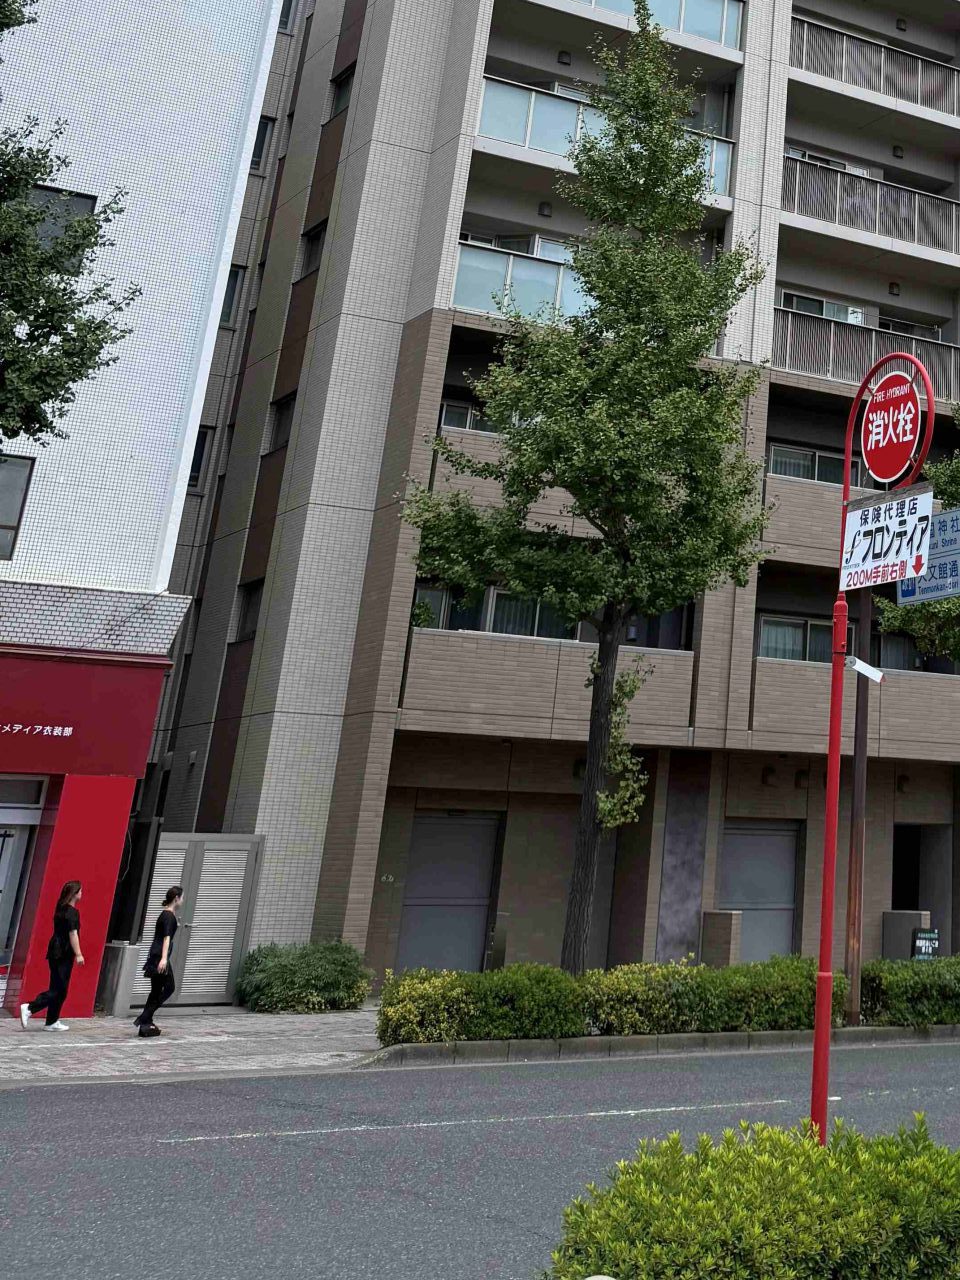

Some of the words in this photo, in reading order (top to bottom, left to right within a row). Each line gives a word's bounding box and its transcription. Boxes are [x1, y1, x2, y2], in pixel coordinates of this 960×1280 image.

[873, 390, 885, 403] FIRE
[886, 383, 910, 399] HYDRANT
[867, 400, 915, 451] 消火栓
[860, 497, 918, 527] 保険代理店
[862, 515, 930, 564] フロンティア
[846, 560, 907, 588] 200M手前右側
[0, 723, 74, 737] メディア衣装部
